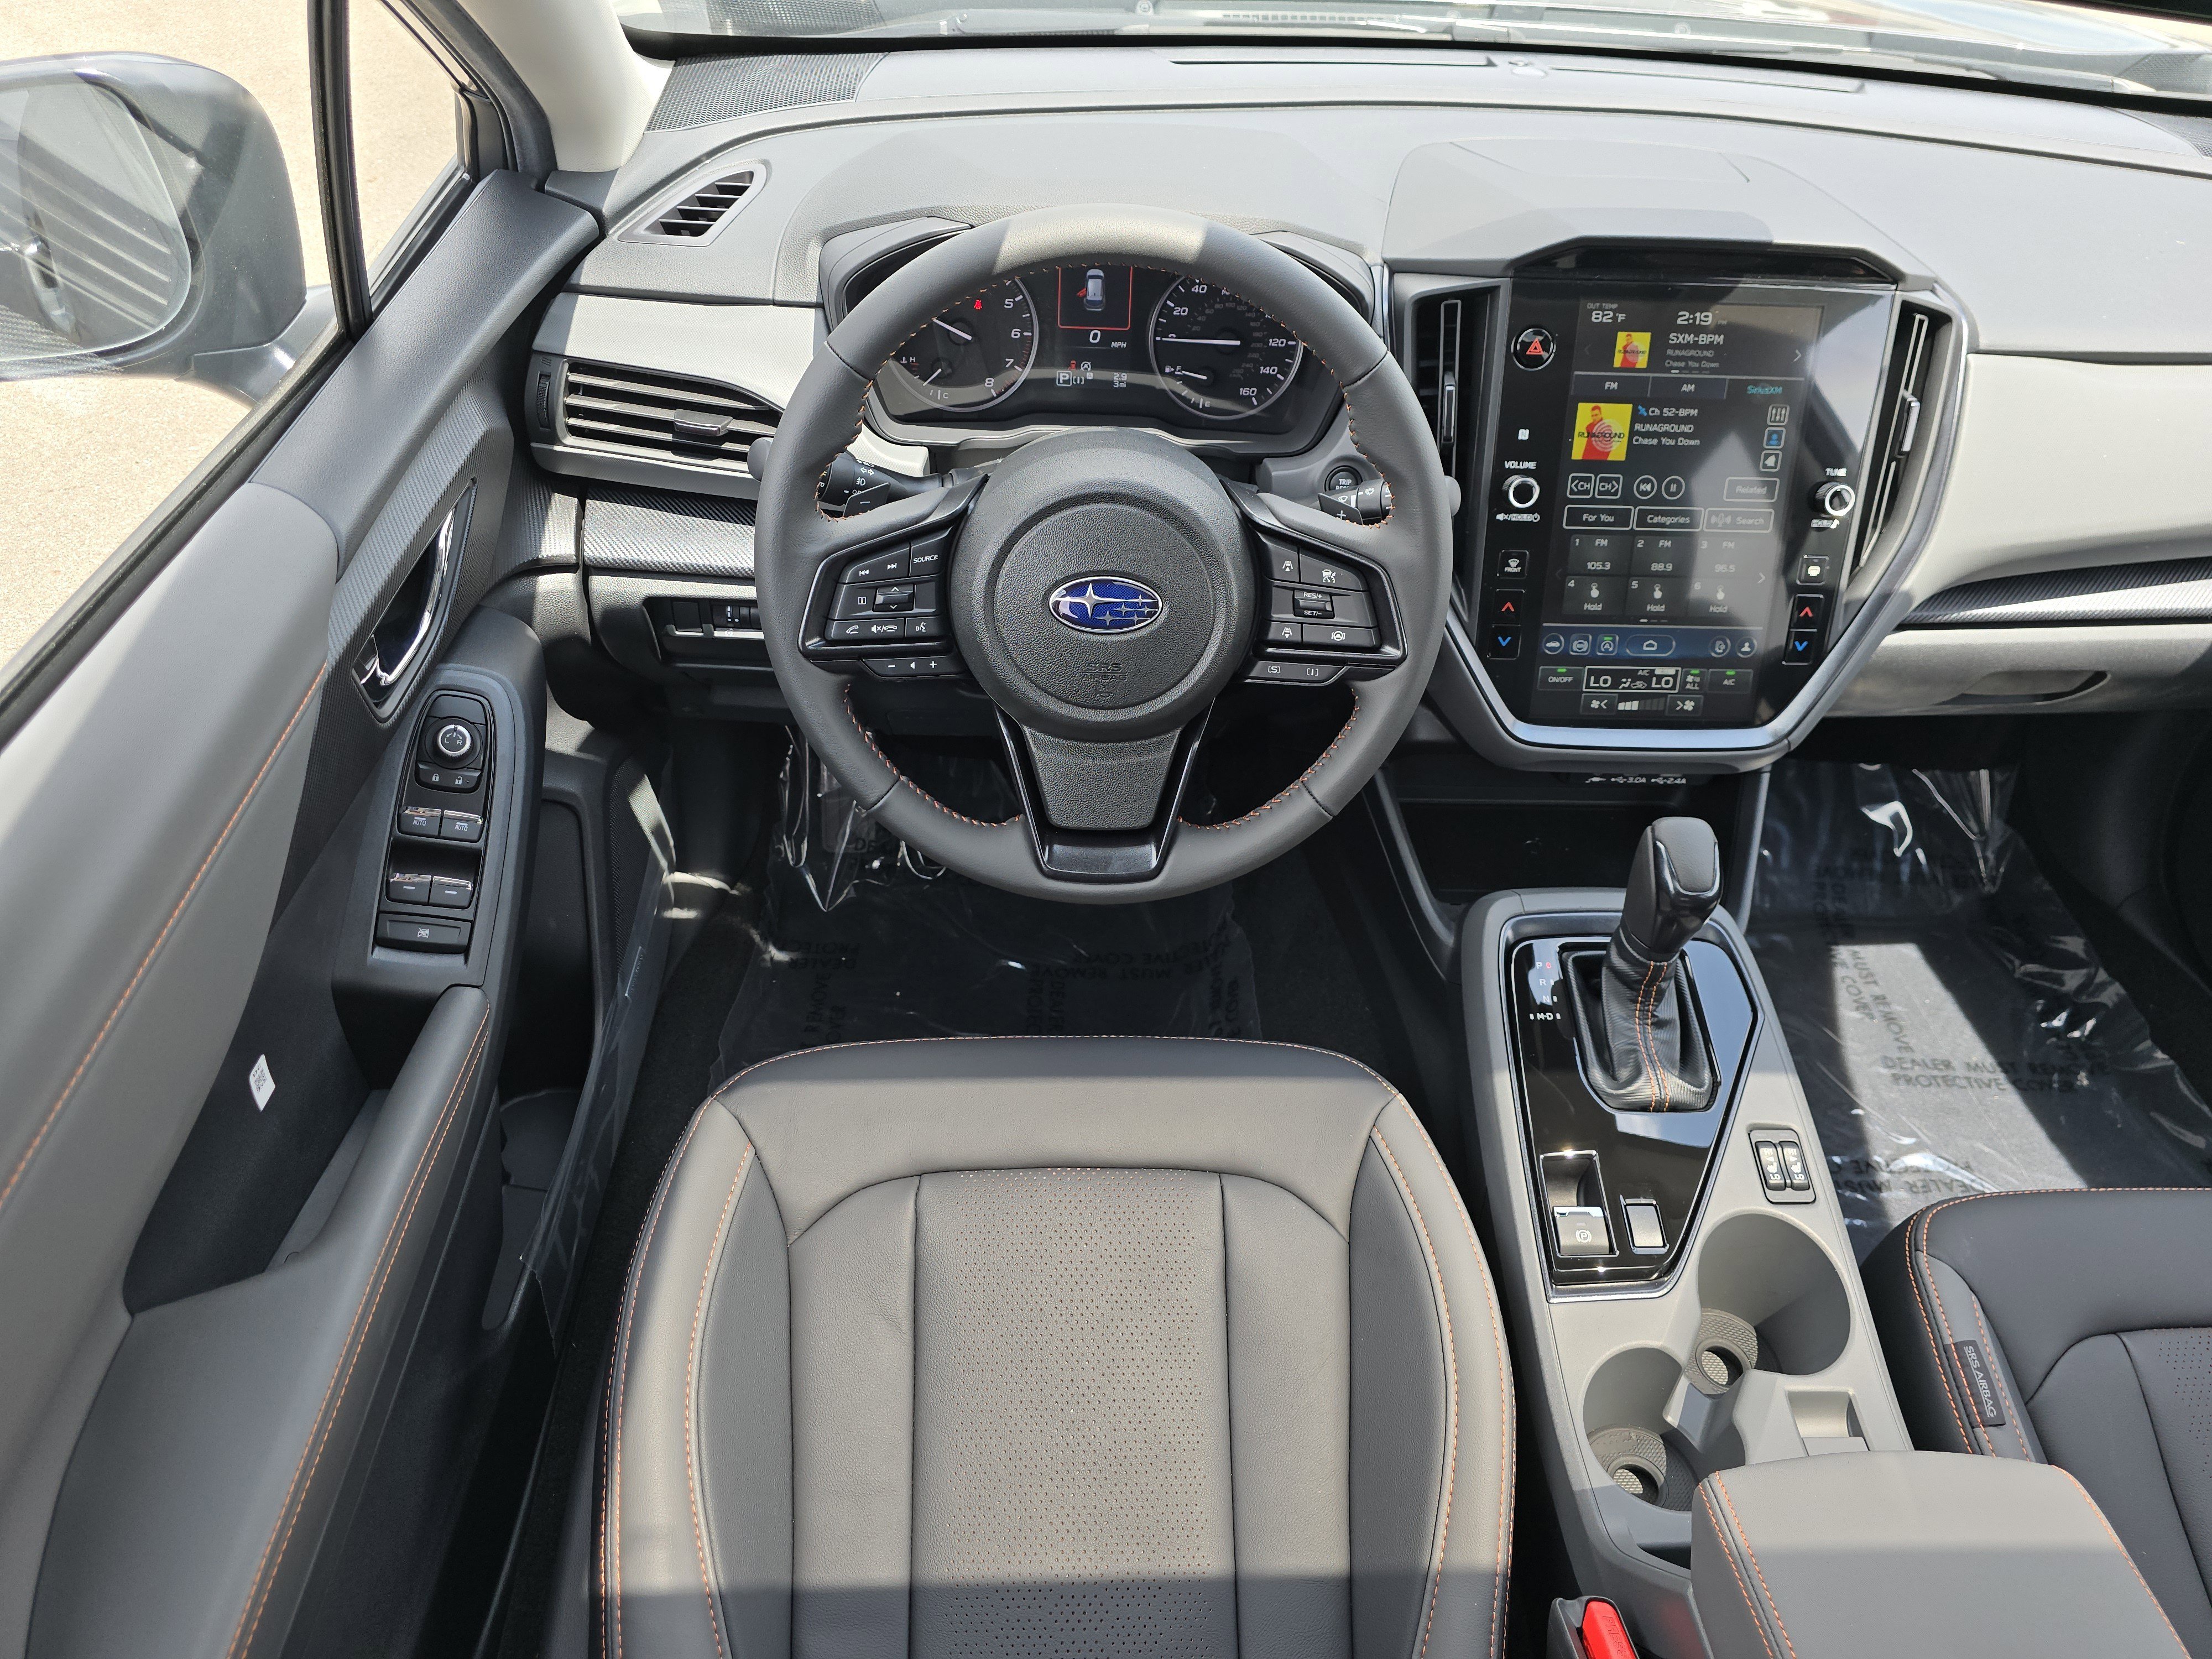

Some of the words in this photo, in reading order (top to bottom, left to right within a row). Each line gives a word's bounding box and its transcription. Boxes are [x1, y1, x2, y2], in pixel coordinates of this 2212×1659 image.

[1191, 284, 1207, 293] 40
[1004, 298, 1014, 309] 5
[1173, 307, 1188, 315] 20
[1591, 310, 1614, 322] 82
[1677, 311, 1713, 325] 2:19
[1011, 328, 1021, 338] 6
[1089, 330, 1101, 343] 0
[1269, 338, 1286, 347] 120
[1668, 332, 1724, 345] SXM-BPM
[1005, 358, 1014, 368] 7
[1260, 366, 1278, 374] 140
[984, 377, 994, 387] 8
[1060, 373, 1070, 384] P
[1604, 382, 1618, 390] FM
[1681, 383, 1695, 392] AM
[1239, 388, 1257, 396] 160
[1648, 407, 1660, 416] Ch
[1634, 423, 1694, 432] RUNAGROUND
[1632, 436, 1658, 446] Chase
[1660, 436, 1675, 446] You
[1677, 437, 1700, 446] Down
[1504, 461, 1537, 469] VOLUME
[1825, 468, 1847, 476] TUNE
[1583, 513, 1597, 522] For
[1599, 513, 1615, 523] You
[1574, 538, 1580, 546] 1
[1595, 538, 1609, 547] FM
[1637, 539, 1645, 547] 2
[1658, 540, 1672, 548] FM
[1700, 540, 1708, 549] 3
[1722, 541, 1735, 549] FM
[913, 554, 938, 564] SOURCE
[1587, 561, 1611, 570] 105.3
[1567, 580, 1575, 588] 4
[1631, 581, 1639, 589] 5
[1646, 604, 1666, 612] Hold
[1709, 605, 1728, 613] Hold
[1590, 675, 1612, 687] LO
[1651, 676, 1674, 688] LO
[413, 818, 426, 827] AUTO
[454, 823, 468, 832] AUTO
[1880, 1055, 1957, 1072] DEALER
[1890, 1072, 2008, 1091] PROTECTIVE
[1964, 1345, 1980, 1369] SRS
[1974, 1370, 1997, 1418] AIRBAG
[1603, 1616, 1627, 1658] PRESS
